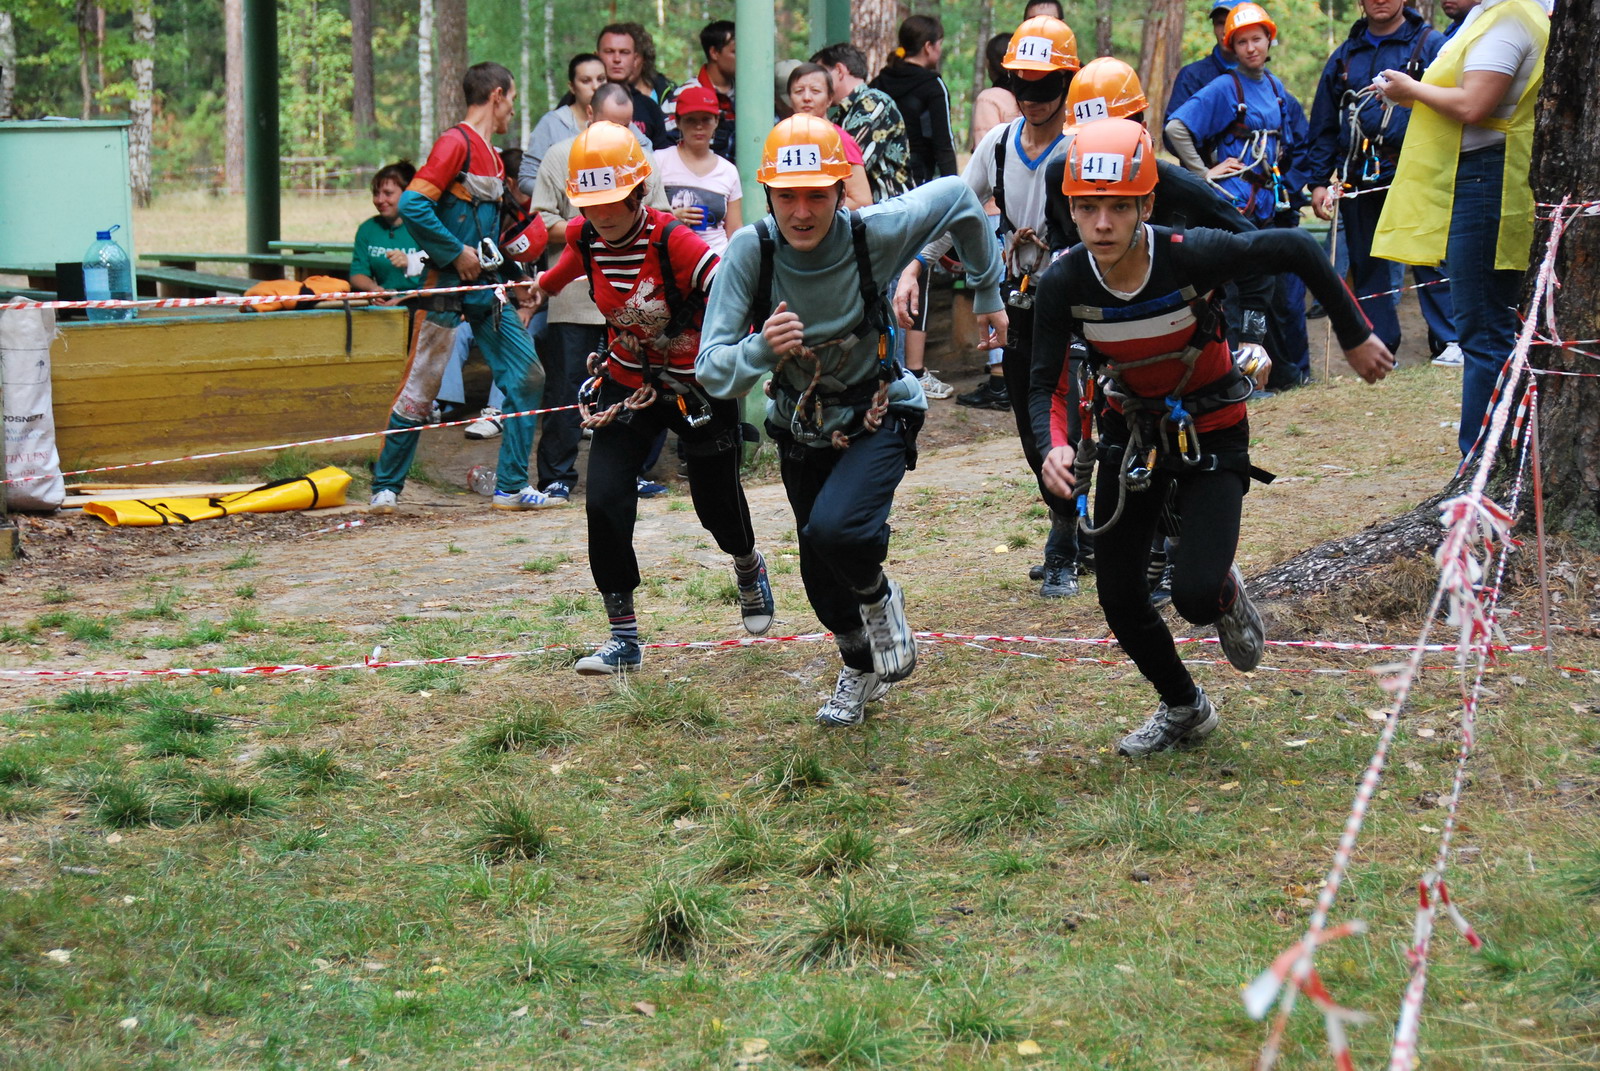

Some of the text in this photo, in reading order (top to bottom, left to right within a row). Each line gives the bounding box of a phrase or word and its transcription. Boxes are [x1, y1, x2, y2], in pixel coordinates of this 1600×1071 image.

[1019, 42, 1047, 58] 41 4
[1076, 102, 1104, 119] 41 2
[782, 148, 817, 166] 41 3
[1083, 156, 1117, 175] 41 1
[580, 171, 612, 187] 41 5
